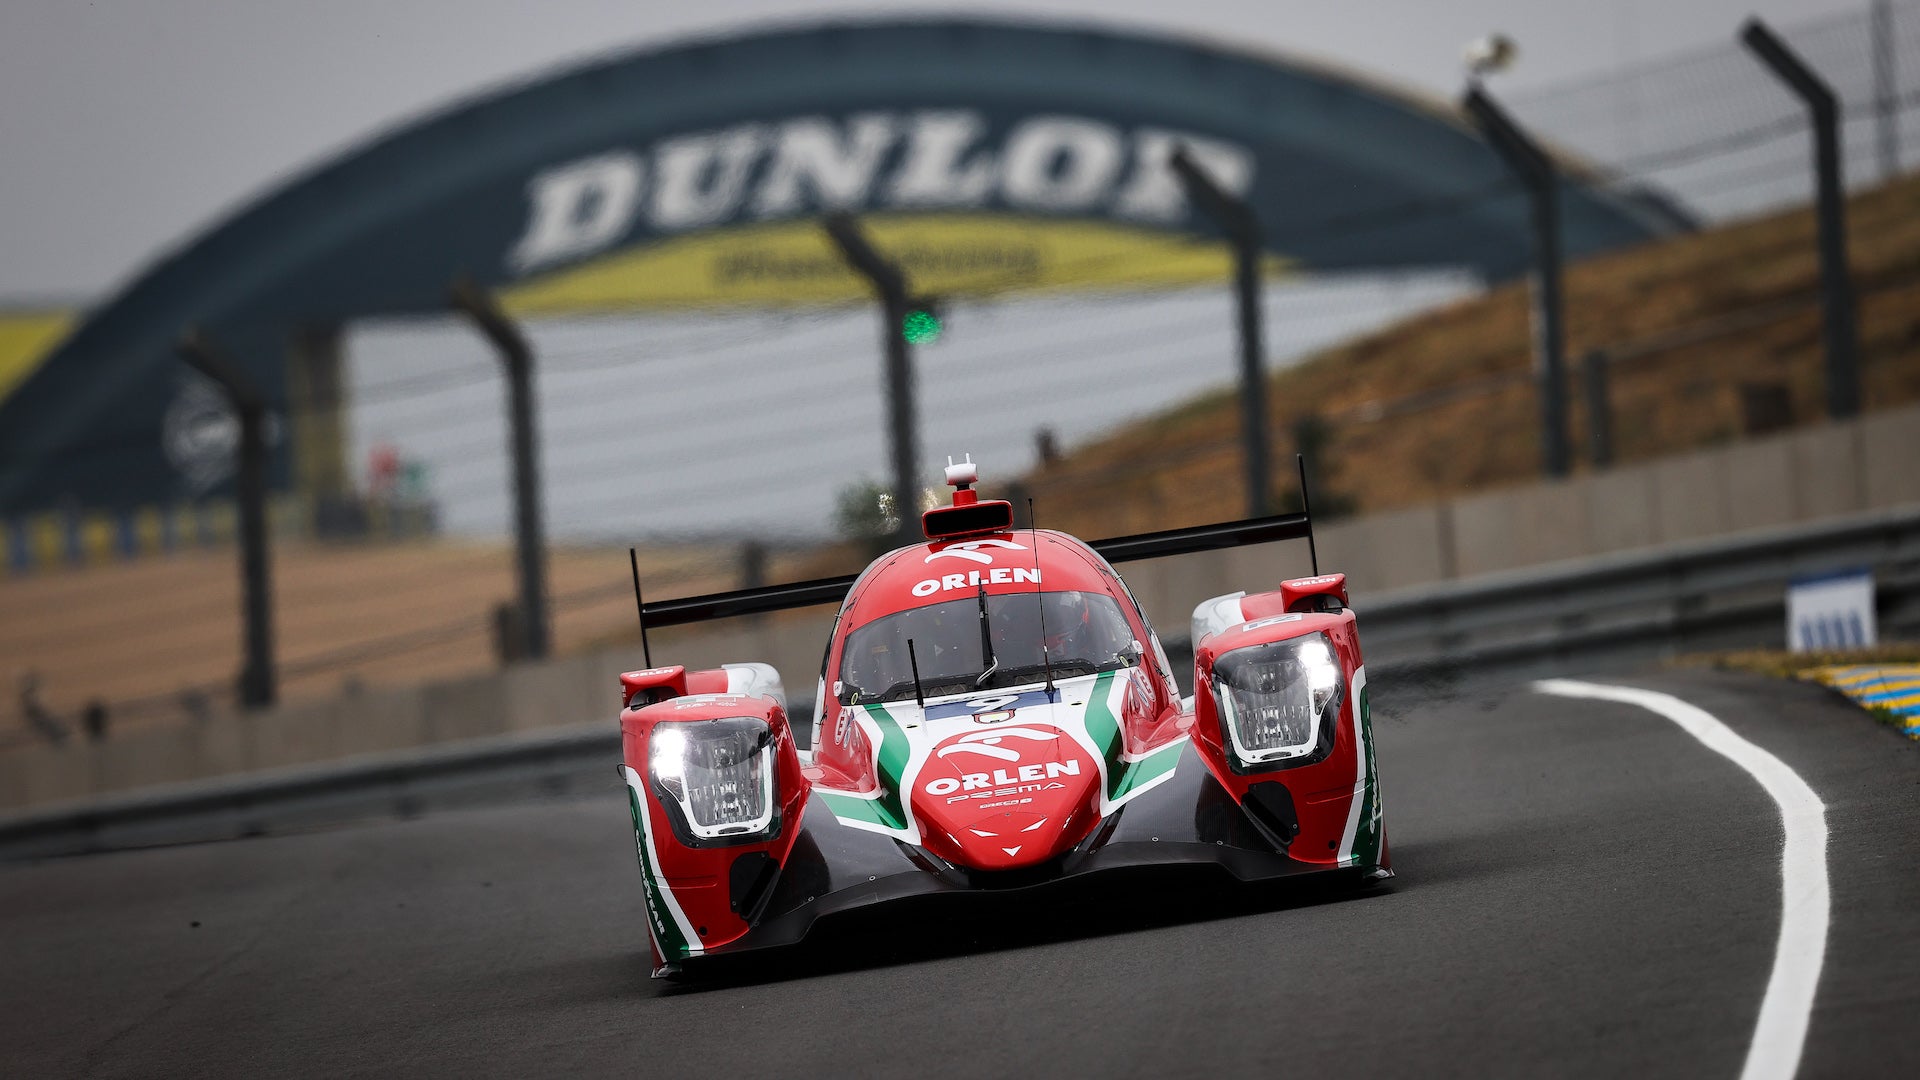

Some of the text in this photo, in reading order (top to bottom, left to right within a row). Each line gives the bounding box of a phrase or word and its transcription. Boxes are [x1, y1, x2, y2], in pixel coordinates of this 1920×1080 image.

[506, 108, 1256, 273] DUNLOP
[911, 567, 1042, 597] ORLEN
[1292, 577, 1336, 587] ORLEN
[628, 668, 674, 678] ORLEN
[925, 759, 1081, 796] ORLEN
[946, 781, 1067, 805] PREMA
